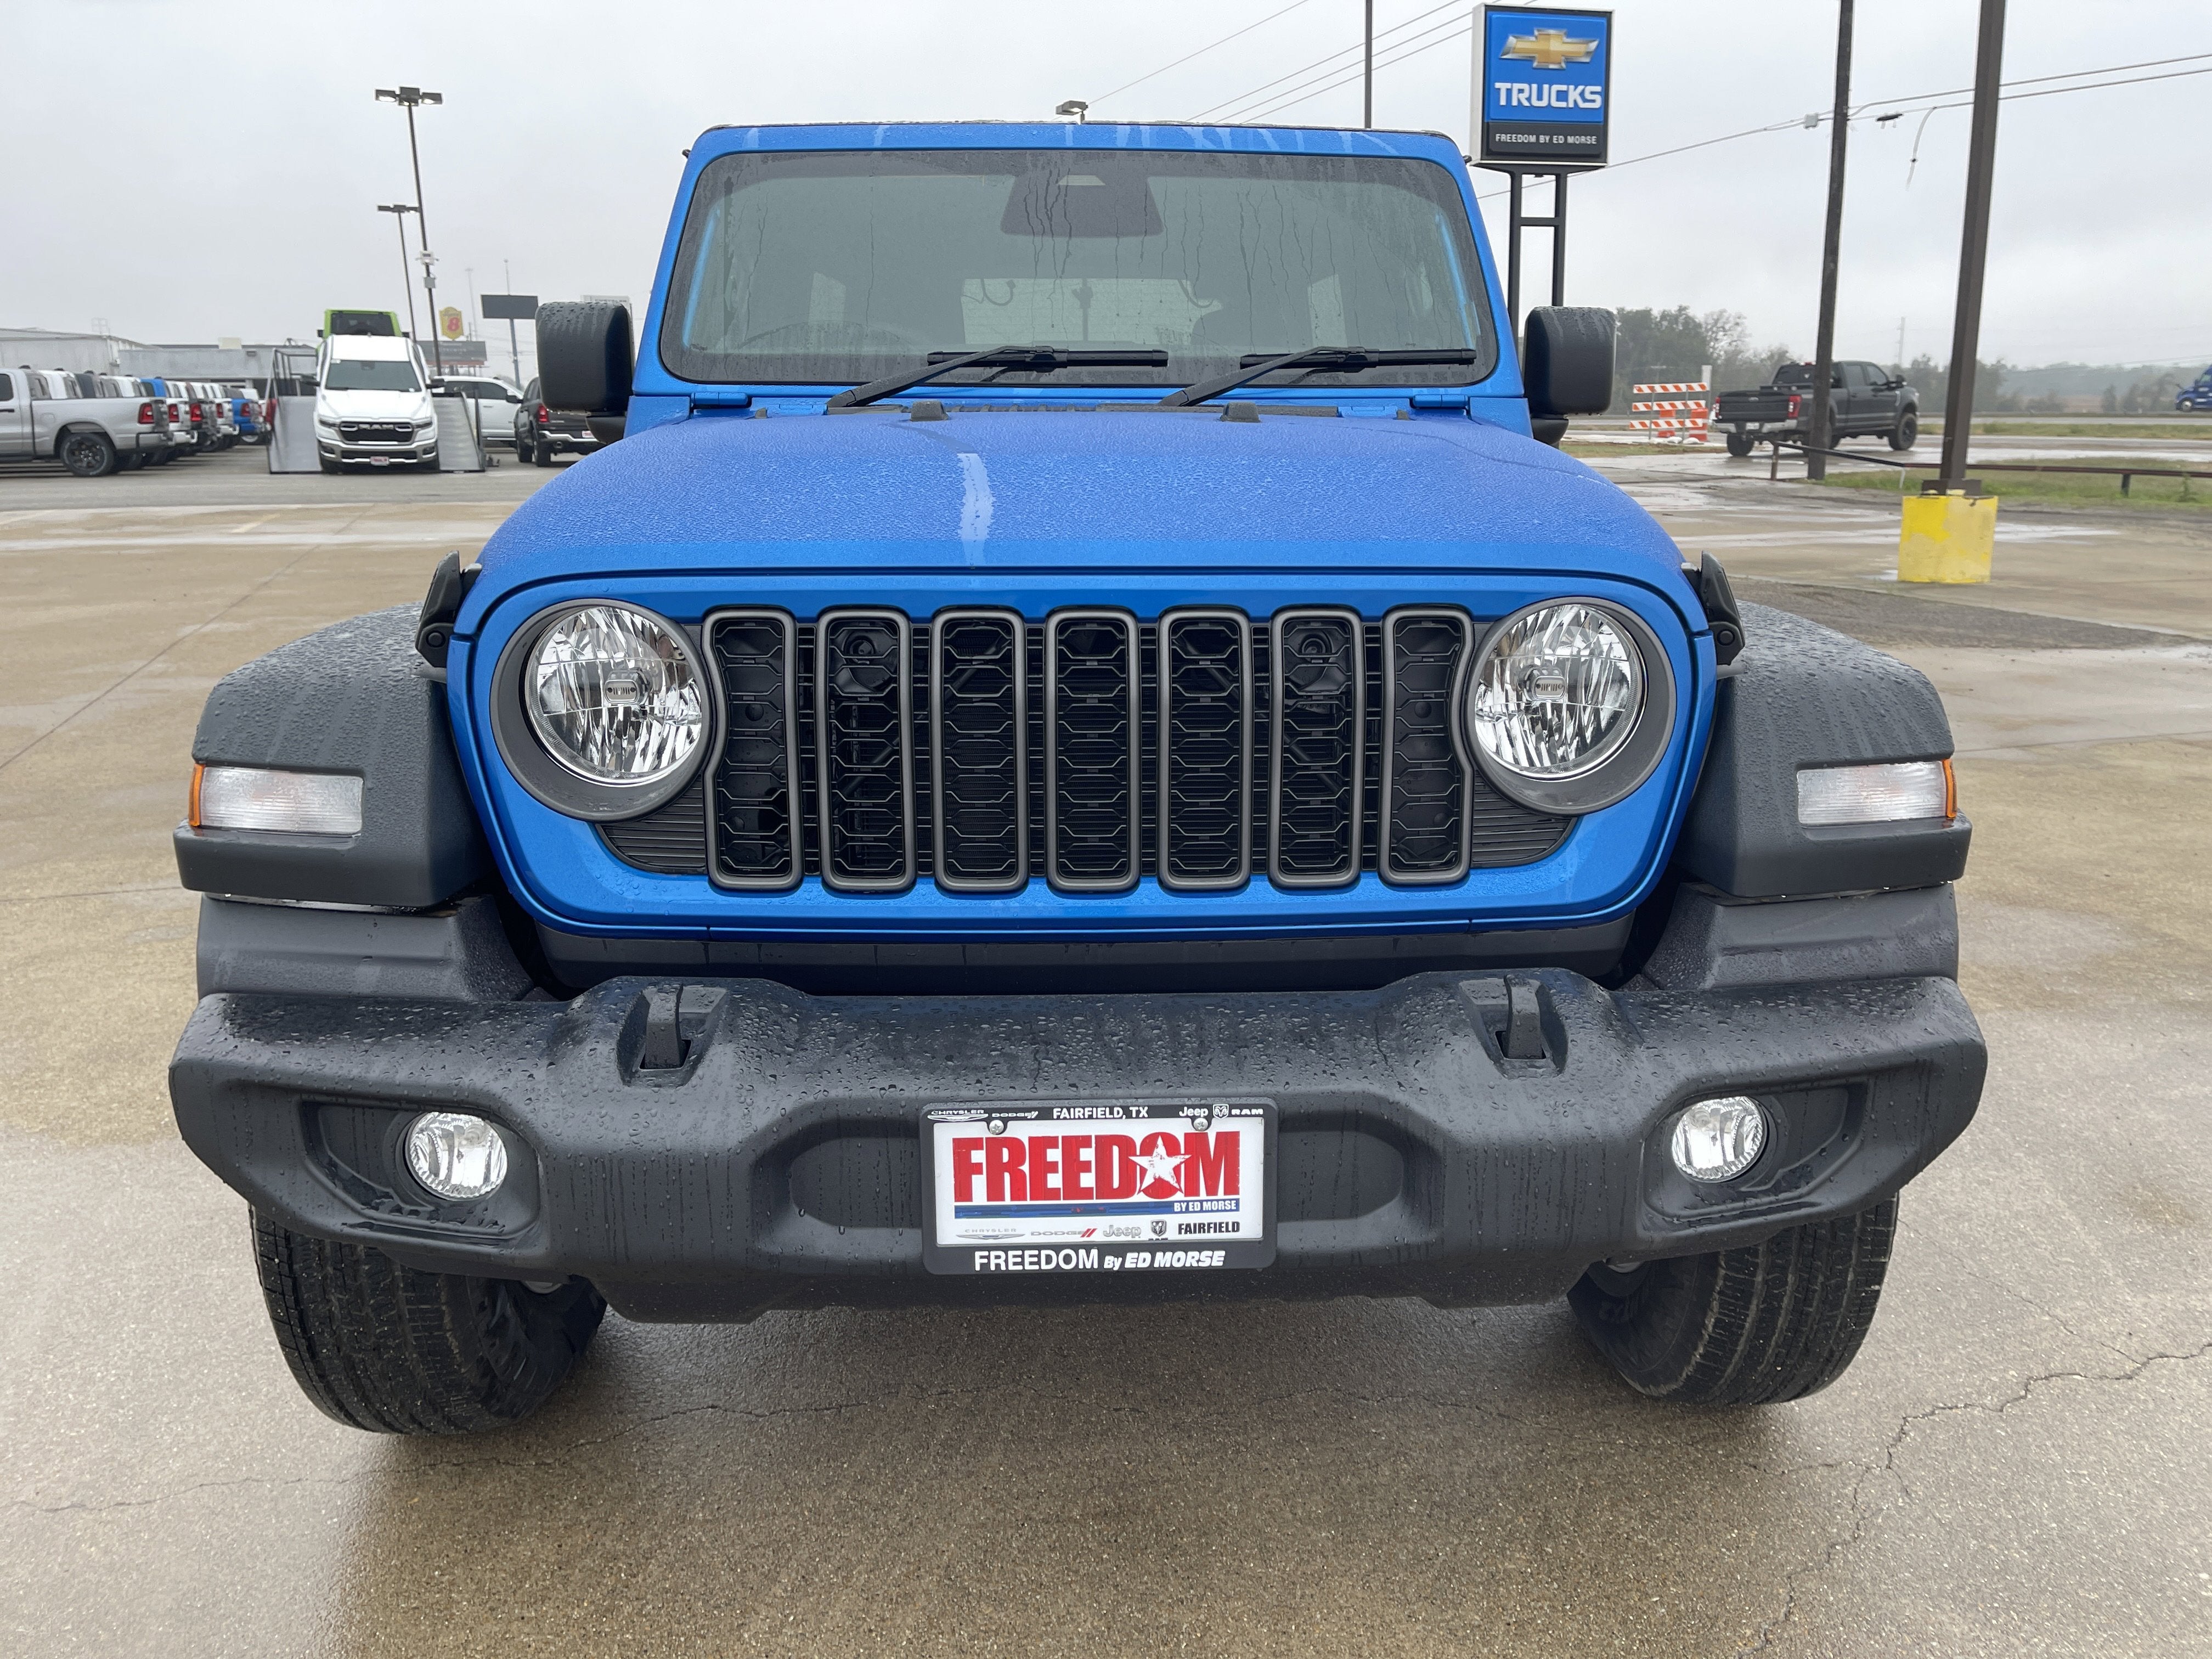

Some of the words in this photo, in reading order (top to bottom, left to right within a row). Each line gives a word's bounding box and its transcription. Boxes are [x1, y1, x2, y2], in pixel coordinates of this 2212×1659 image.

[1494, 82, 1602, 109] TRUCKS
[1496, 134, 1536, 143] FREEDOM
[1539, 135, 1550, 143] BY
[1553, 136, 1565, 144] ED
[1567, 136, 1597, 144] MORSE
[1053, 1107, 1127, 1120] FAIRFIELD,
[1129, 1106, 1149, 1118] TX
[1179, 1106, 1209, 1118] Jeep
[952, 1131, 1240, 1203] FREEDOM
[1173, 1202, 1187, 1212] BY
[1189, 1201, 1201, 1211] ED
[1204, 1200, 1237, 1211] MORSE
[1103, 1224, 1142, 1239] Jeep
[1177, 1221, 1240, 1235] FAIRFIELD
[974, 1248, 1098, 1271] FREEDOM
[1103, 1255, 1122, 1271] By
[1125, 1251, 1152, 1268] ED
[1154, 1250, 1226, 1268] MORSE
